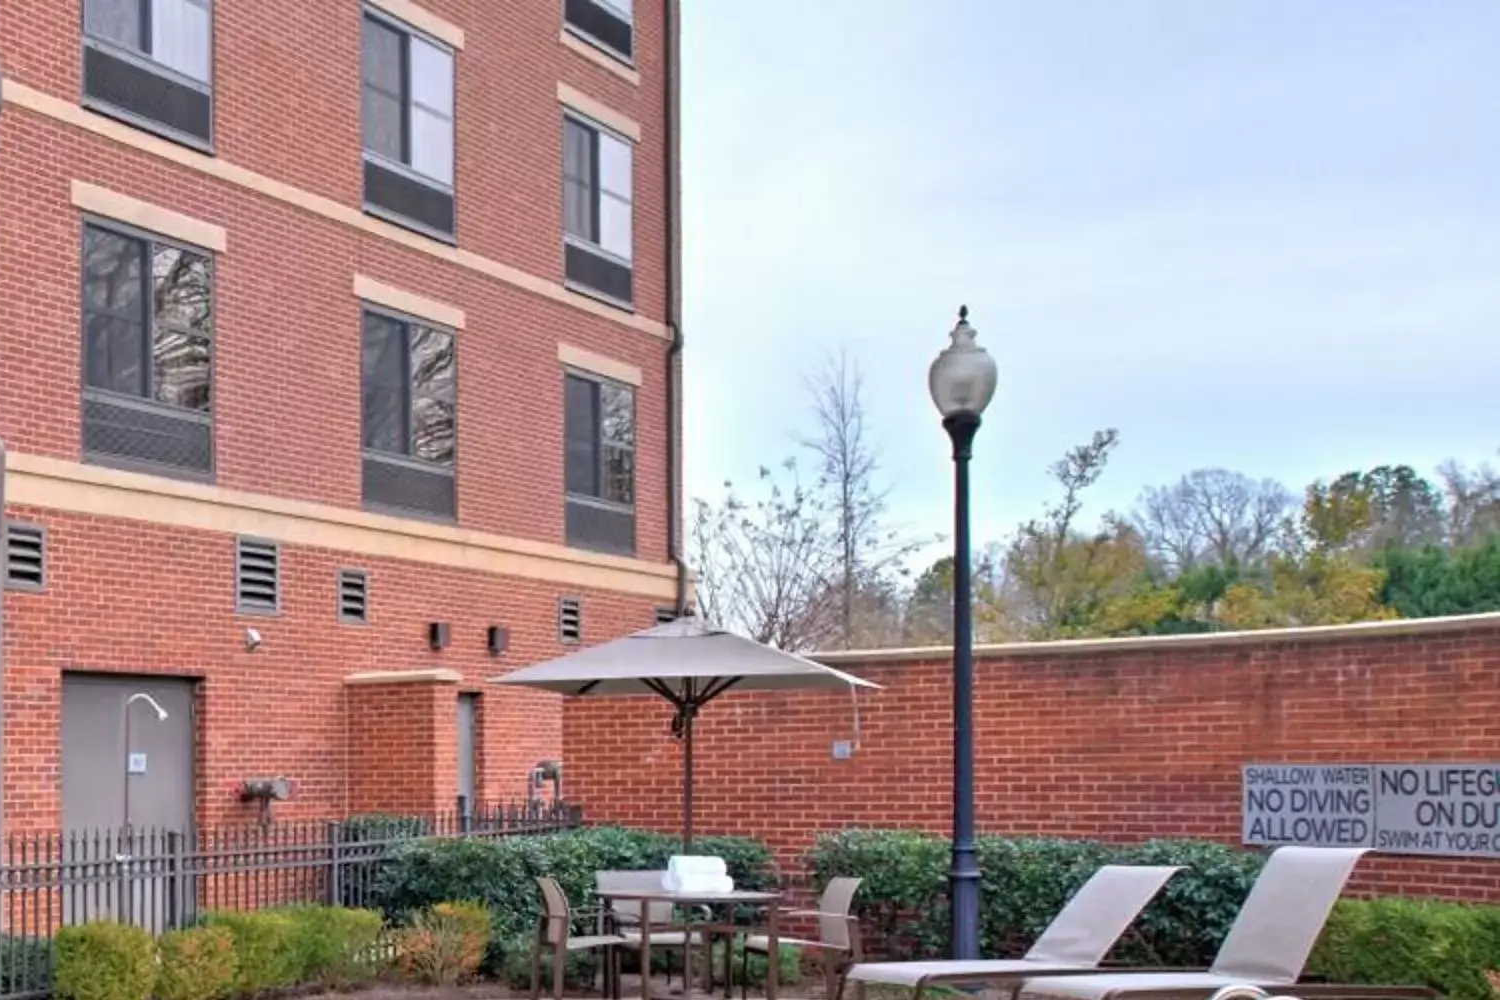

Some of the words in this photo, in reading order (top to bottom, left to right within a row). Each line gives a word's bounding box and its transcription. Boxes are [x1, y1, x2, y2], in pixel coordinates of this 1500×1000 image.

[1246, 768, 1316, 785] SHALLOW
[1321, 768, 1370, 785] WATER
[1381, 769, 1420, 796] NO
[1247, 789, 1284, 813] NO
[1291, 789, 1371, 815] DIVING
[1416, 801, 1455, 828] ON
[1249, 817, 1368, 843] ALLOWED
[1379, 830, 1419, 848] SWIM
[1421, 831, 1442, 849] AT
[1445, 832, 1490, 852] YOUR
